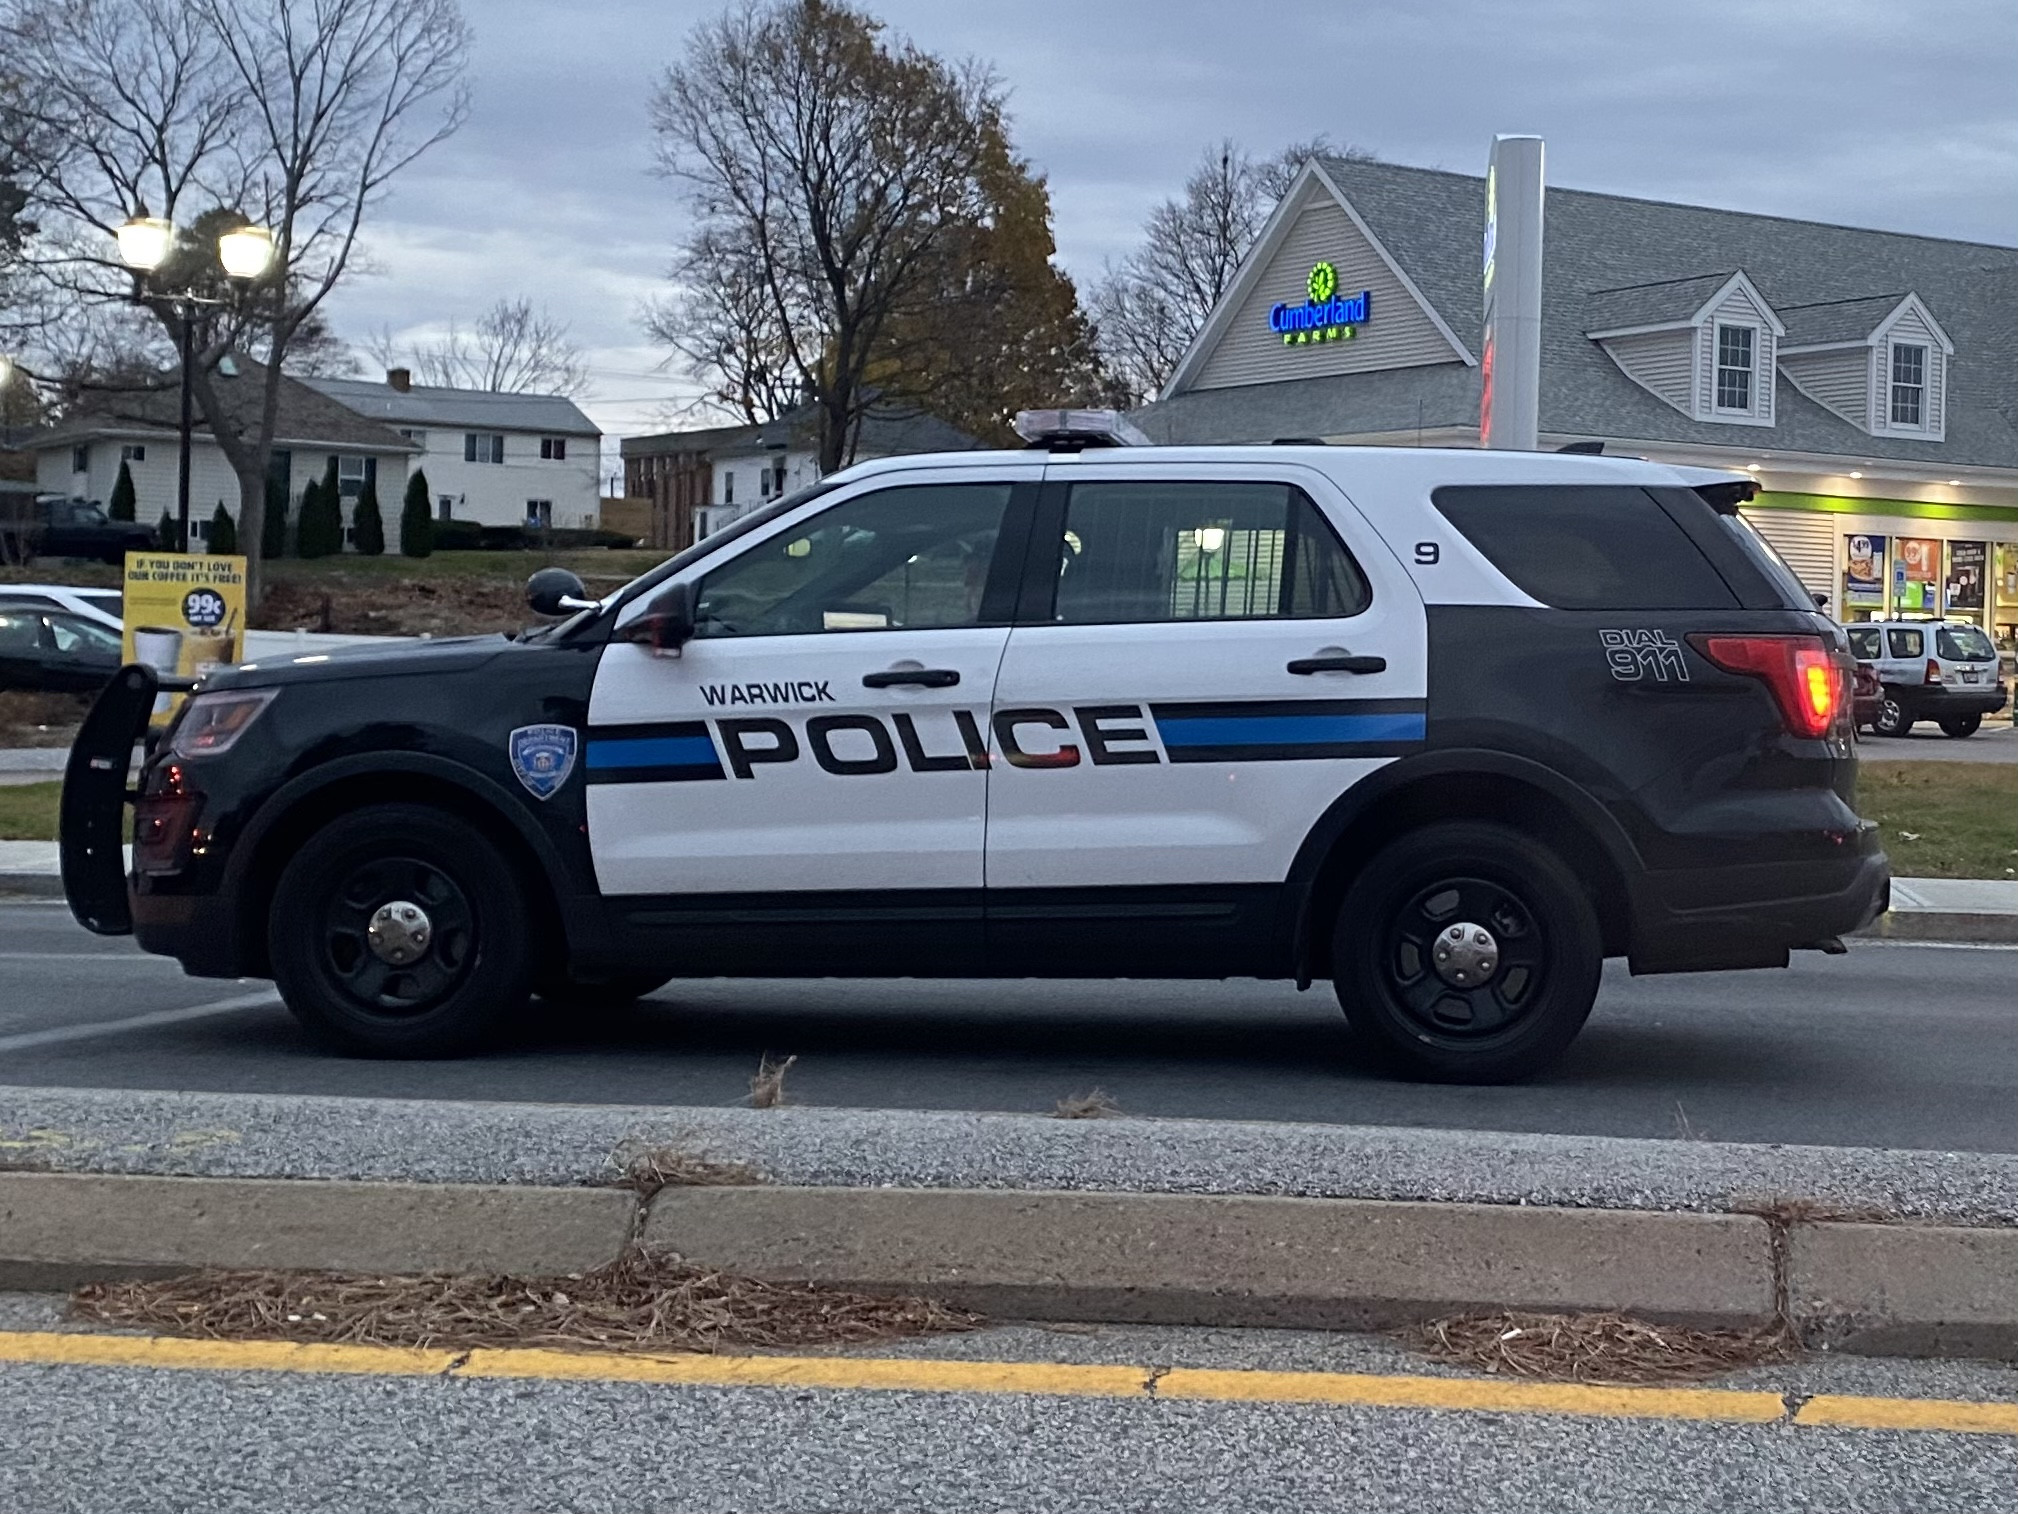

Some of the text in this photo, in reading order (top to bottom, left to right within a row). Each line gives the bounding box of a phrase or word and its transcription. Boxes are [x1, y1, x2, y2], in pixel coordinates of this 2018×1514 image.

[1269, 291, 1368, 333] Cumberland
[1283, 326, 1352, 345] FARMS
[1414, 542, 1440, 565] 9
[128, 571, 149, 581] OUR
[152, 572, 187, 583] COFFEE
[136, 560, 233, 573] IF YOU DON'T LOVE
[1598, 629, 1679, 648] DIAL
[1606, 647, 1690, 682] 911
[699, 680, 836, 706] WARWICK
[715, 704, 1161, 780] POLICE
